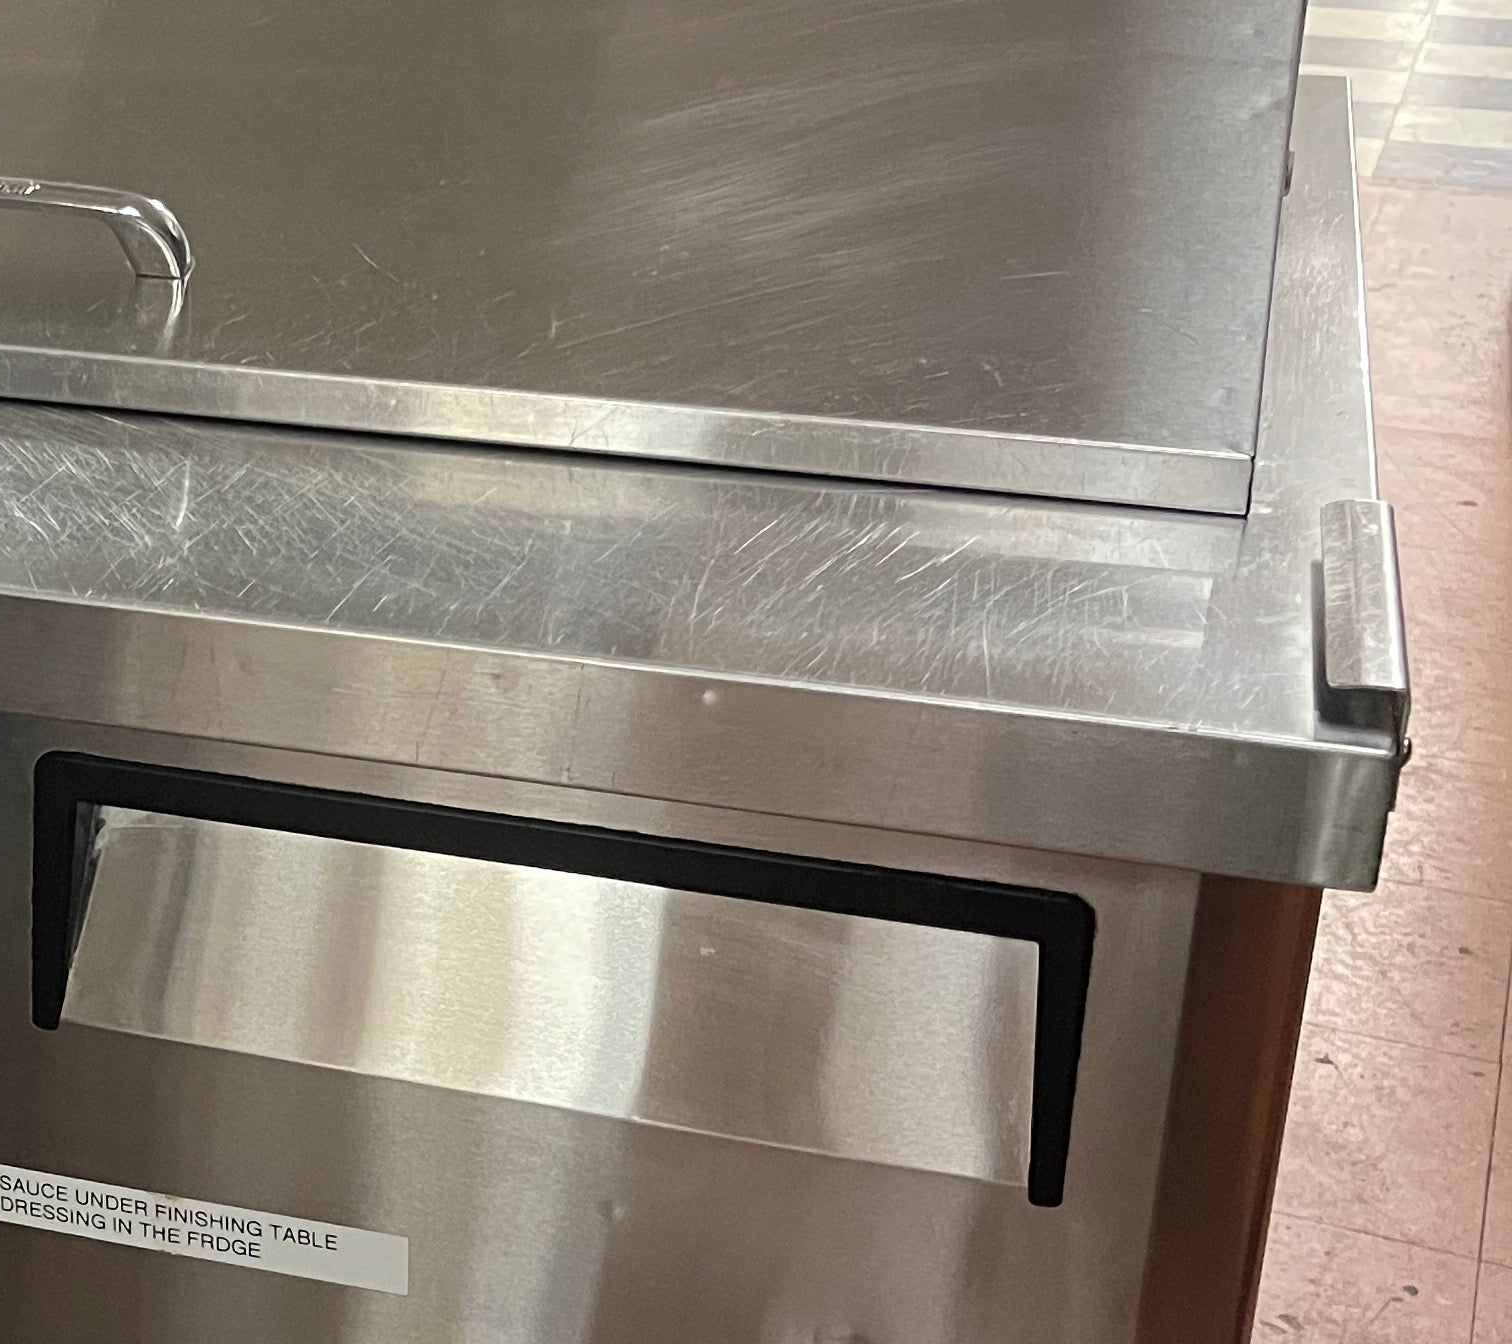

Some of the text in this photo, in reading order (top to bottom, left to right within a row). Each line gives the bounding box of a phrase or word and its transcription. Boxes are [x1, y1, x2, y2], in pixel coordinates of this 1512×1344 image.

[0, 1174, 338, 1251] SAUCE UNDER FINISHING TABLE
[0, 1196, 262, 1259] DRESSING IN THE FRDGE
